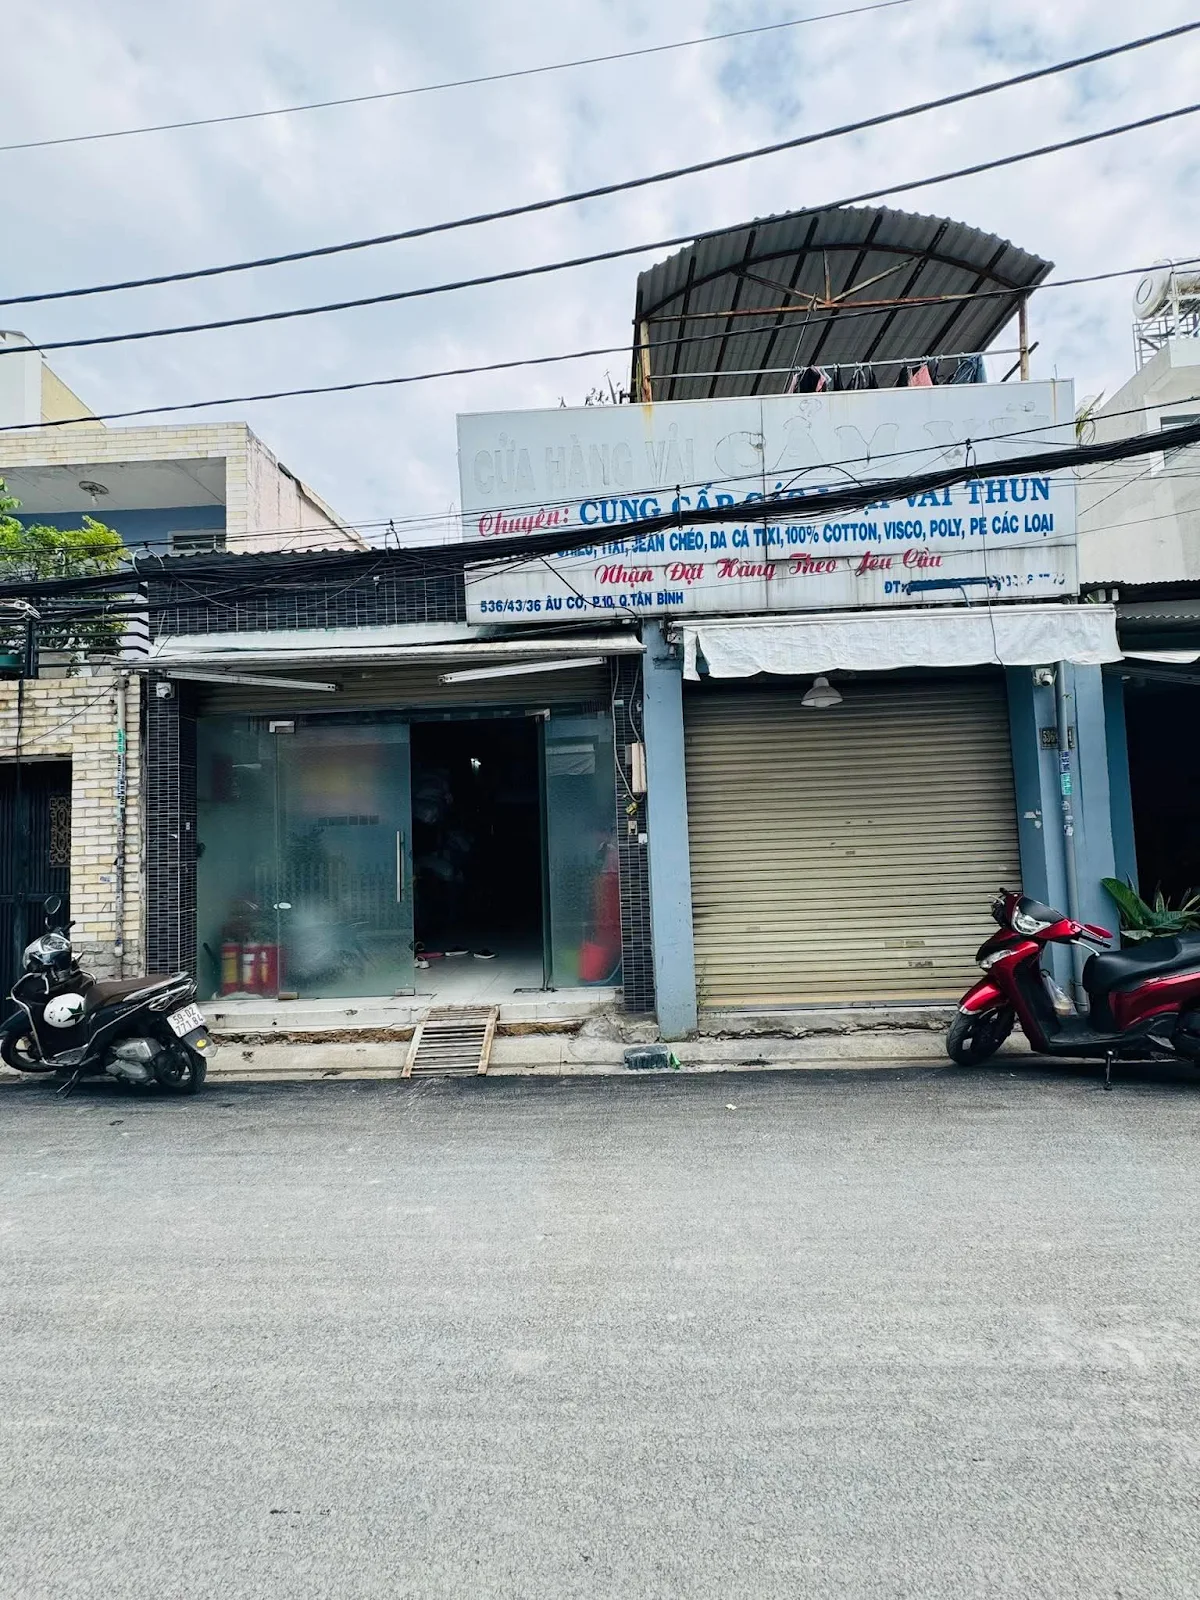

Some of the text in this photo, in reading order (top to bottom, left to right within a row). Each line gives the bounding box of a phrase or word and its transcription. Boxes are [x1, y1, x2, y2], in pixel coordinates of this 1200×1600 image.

[964, 477, 1051, 505] THUN
[478, 507, 569, 537] Chuyên:
[580, 497, 661, 525] CUNG
[631, 533, 665, 553] JEAN
[669, 527, 708, 552] CHÉO,
[710, 530, 727, 549] DA
[732, 525, 750, 548] CÁ
[786, 525, 819, 545] 100%
[822, 522, 882, 544] COTTON,
[883, 519, 926, 542] VISCO,
[930, 518, 965, 539] POLY,
[970, 516, 987, 535] PE
[991, 511, 1019, 534] CÁC
[1024, 513, 1054, 537] LOẠI
[594, 564, 654, 588] Nhận
[664, 561, 705, 585] Đặt
[716, 557, 777, 581] Hàng
[788, 552, 838, 575] Theo
[902, 547, 944, 569] Cầu
[480, 599, 541, 613] 536/43/36
[545, 595, 562, 611] ÂU
[619, 591, 652, 607] Q.TÂN
[657, 589, 684, 606] BÌNH
